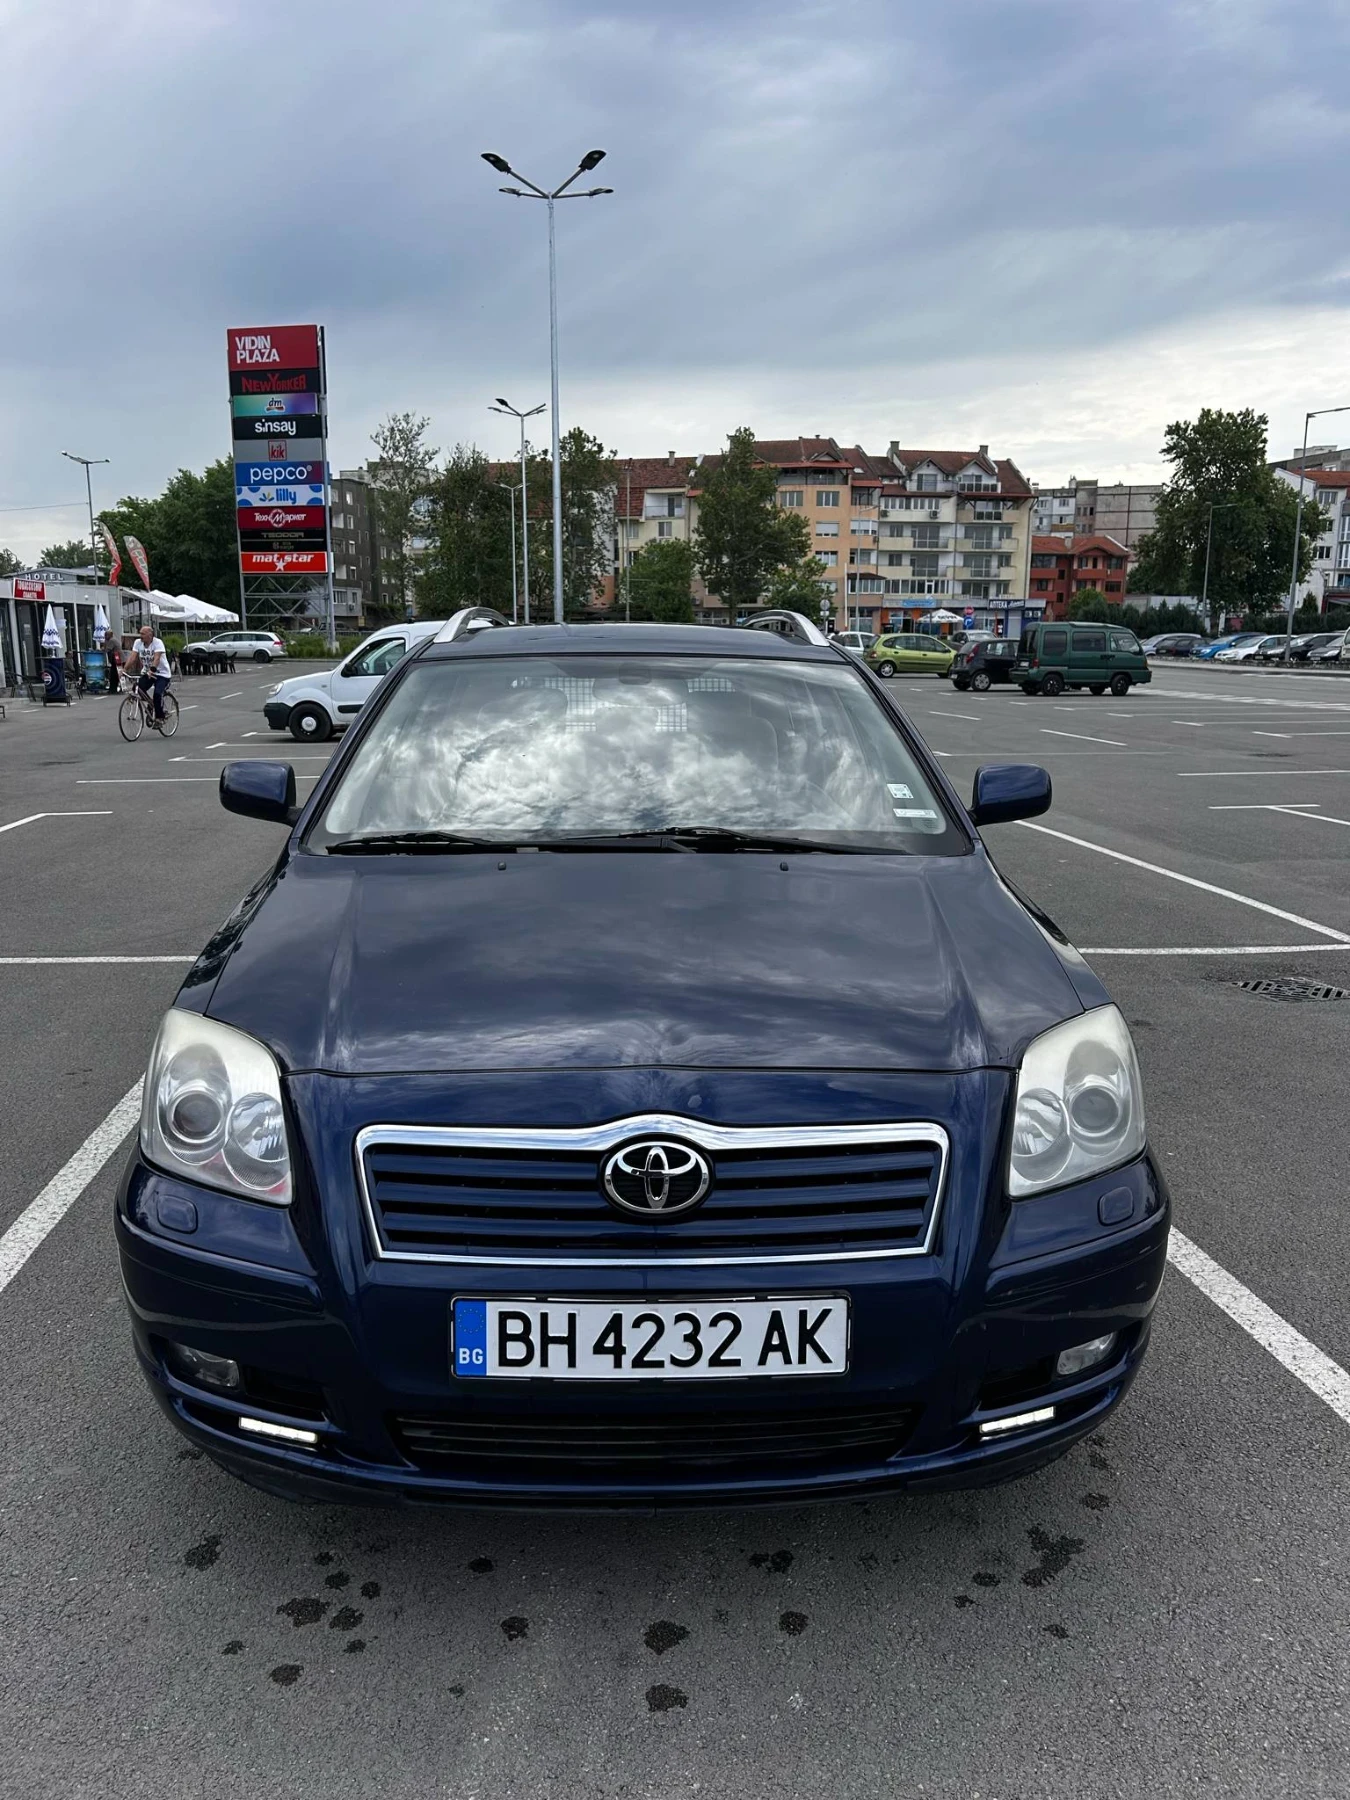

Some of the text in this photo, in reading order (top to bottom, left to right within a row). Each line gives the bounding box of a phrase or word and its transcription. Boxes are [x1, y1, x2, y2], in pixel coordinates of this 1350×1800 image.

[235, 335, 271, 350] VIDIN
[236, 348, 280, 364] PLAZA
[268, 398, 283, 407] dm
[254, 418, 296, 435] sinsay
[271, 444, 285, 459] kik
[250, 466, 308, 483] pepco
[276, 488, 297, 504] lilly
[252, 553, 315, 563] mat star
[25, 573, 64, 581] HOTEL
[989, 600, 1008, 609] АПТЕКА
[458, 1308, 833, 1370] BG BH 4232 AK
